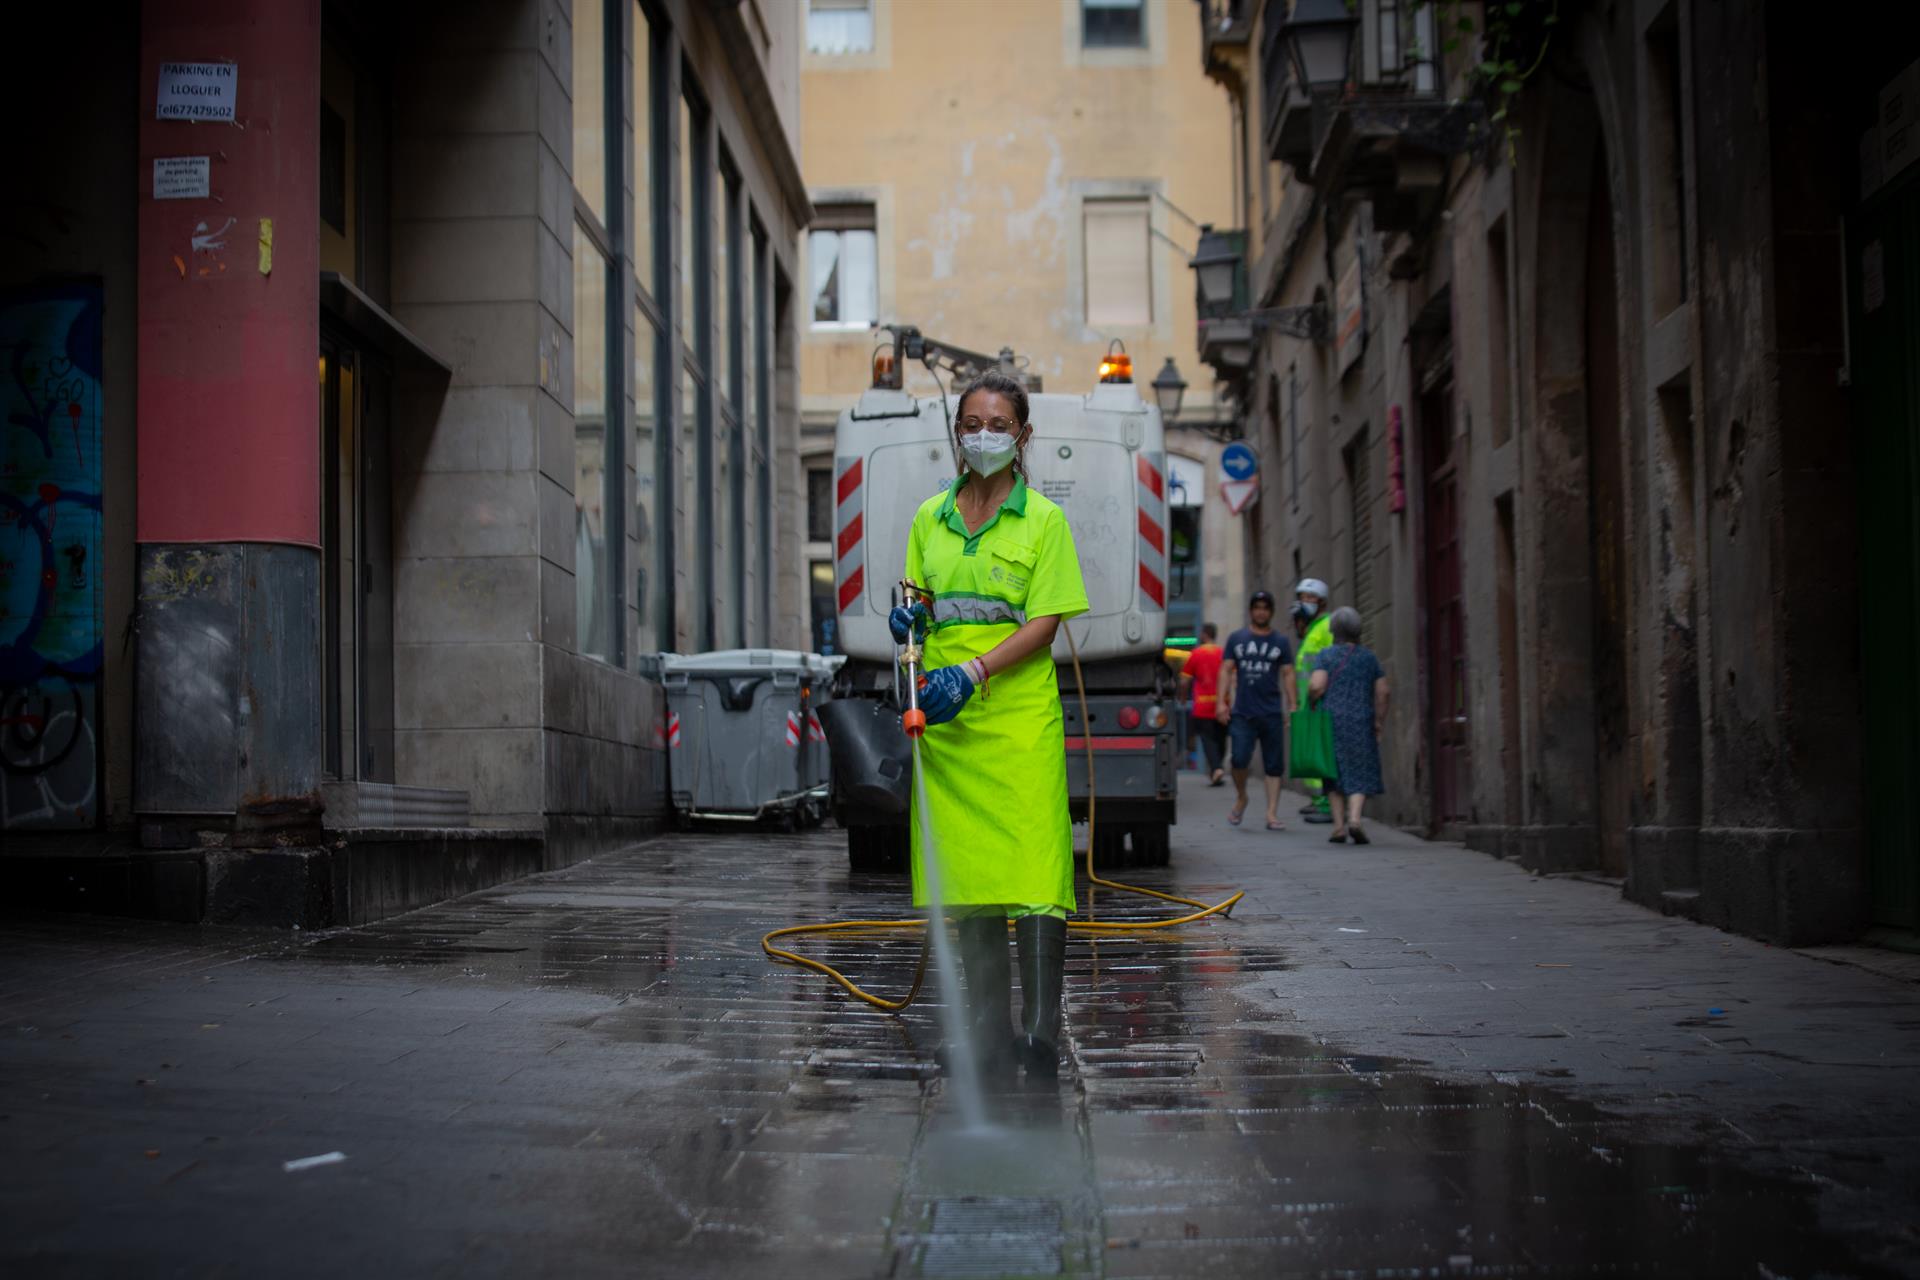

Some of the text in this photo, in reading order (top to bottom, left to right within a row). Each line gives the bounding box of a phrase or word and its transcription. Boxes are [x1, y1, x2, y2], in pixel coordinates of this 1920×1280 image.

[163, 64, 231, 77] PARKING EN
[170, 84, 221, 96] LLOGUER
[158, 104, 232, 118] Tel677479502
[1240, 660, 1272, 673] PLAY
